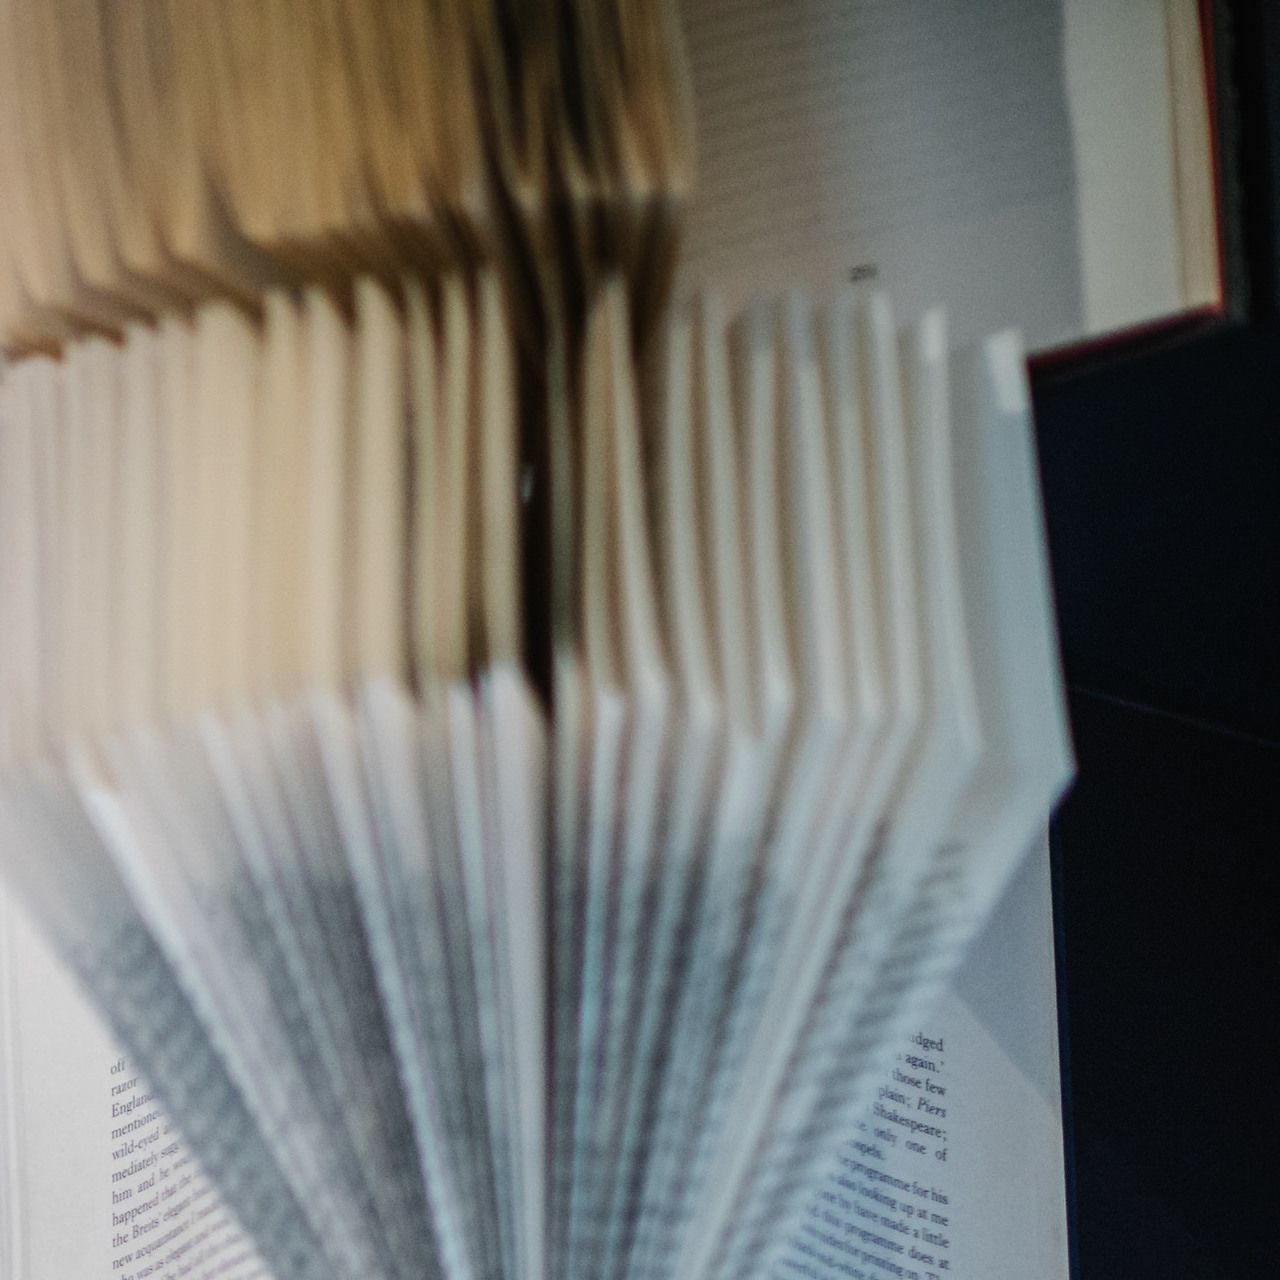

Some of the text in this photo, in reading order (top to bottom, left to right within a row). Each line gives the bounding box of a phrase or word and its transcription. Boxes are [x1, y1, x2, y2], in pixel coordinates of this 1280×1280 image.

[111, 1077, 139, 1096] razor
[892, 1068, 946, 1097] those few
[917, 1097, 947, 1119] Piers
[872, 1102, 947, 1143] Shakespeare;
[111, 1126, 160, 1162] wild-eyed
[905, 1139, 928, 1156] one
[934, 1147, 949, 1163] of
[111, 1149, 159, 1184] mediately
[111, 1187, 134, 1206] him
[137, 1171, 156, 1195] and
[111, 1190, 160, 1228] happened
[931, 1212, 950, 1228] me
[111, 1231, 130, 1249] the
[111, 1251, 134, 1271] new
